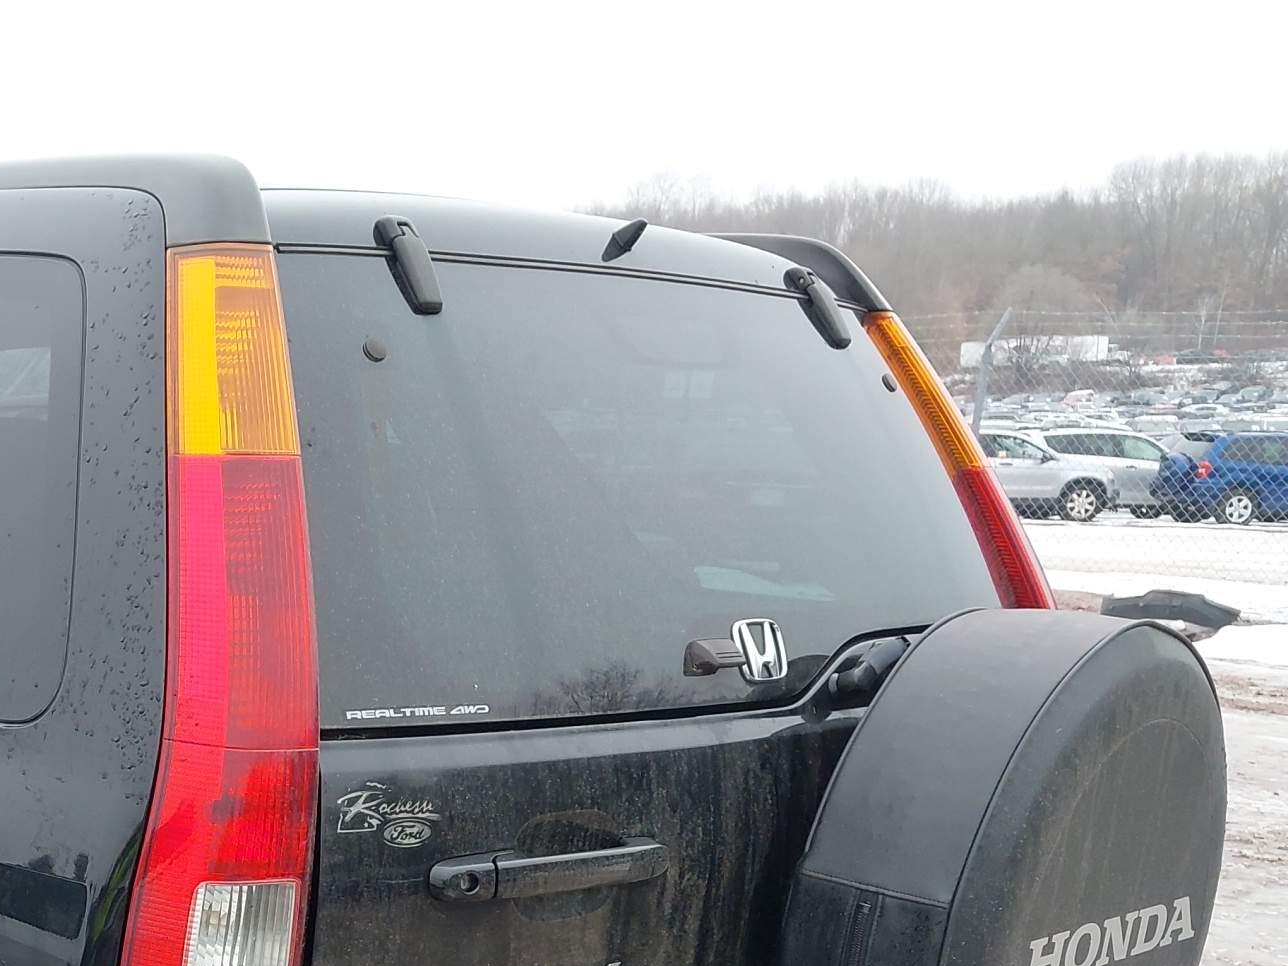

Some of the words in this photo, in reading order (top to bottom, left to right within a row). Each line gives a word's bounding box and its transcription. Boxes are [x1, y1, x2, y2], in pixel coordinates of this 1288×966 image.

[346, 706, 446, 720] REALTIME
[450, 704, 490, 715] 4WD
[390, 822, 426, 841] Ford
